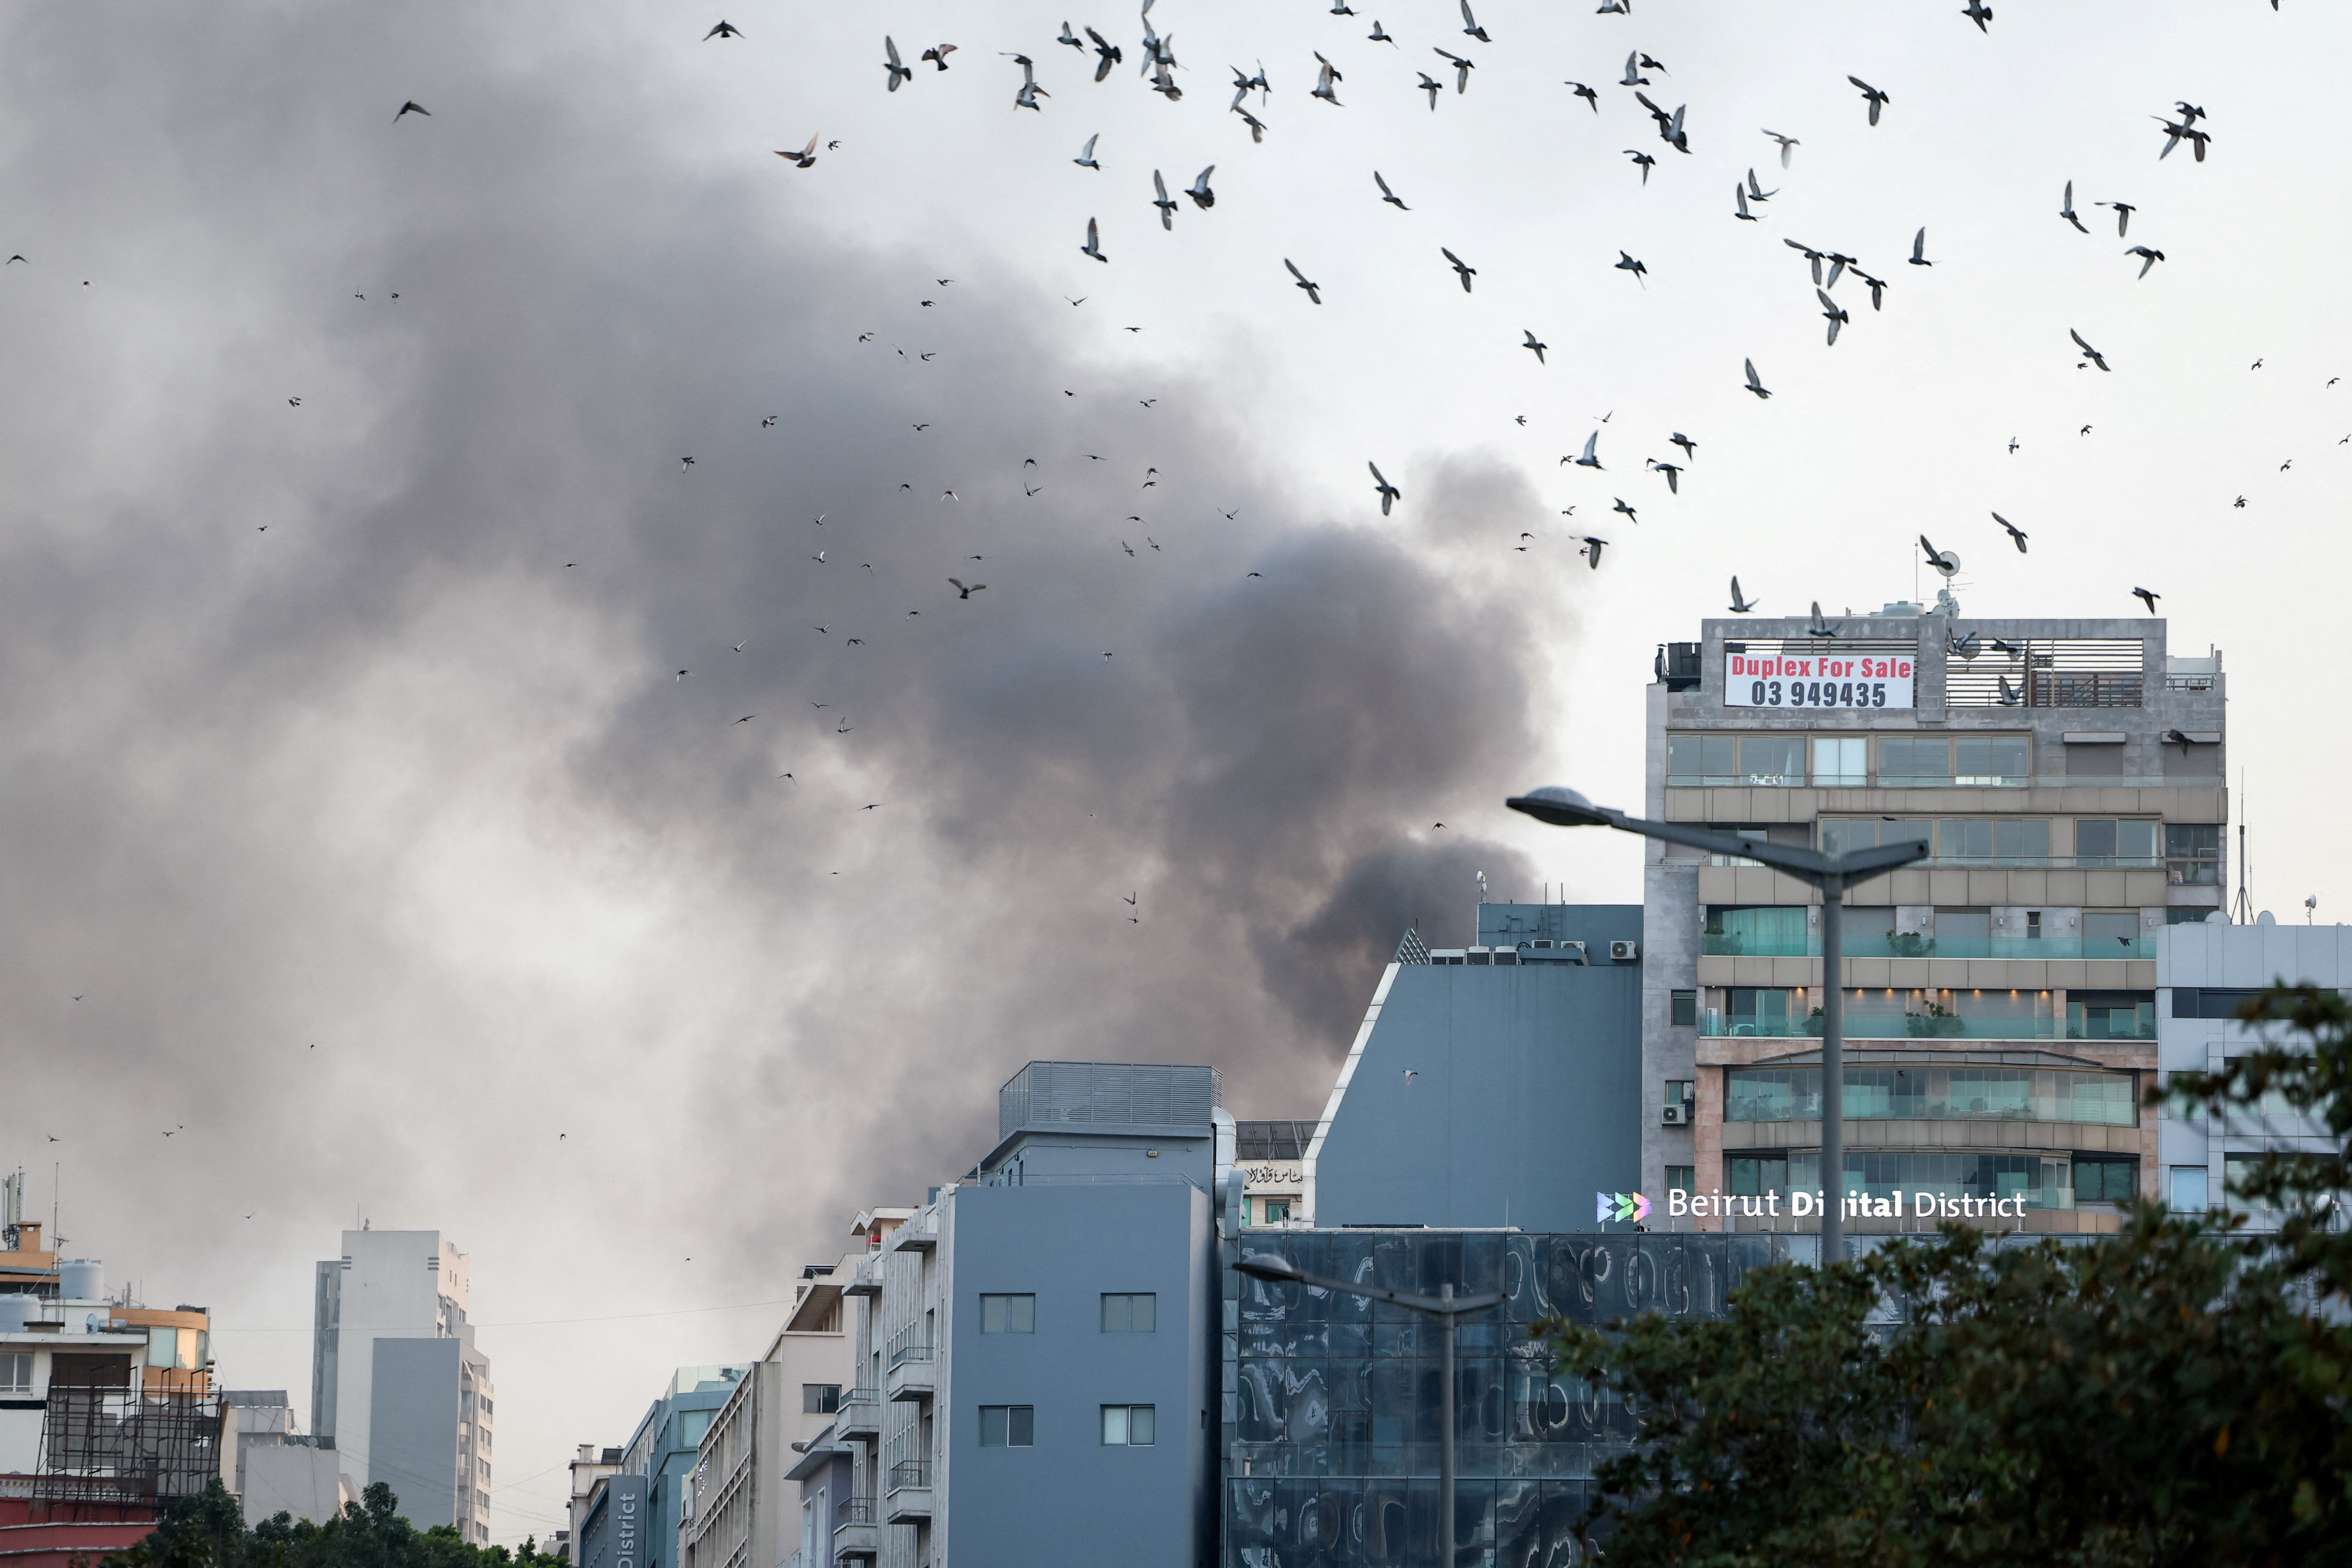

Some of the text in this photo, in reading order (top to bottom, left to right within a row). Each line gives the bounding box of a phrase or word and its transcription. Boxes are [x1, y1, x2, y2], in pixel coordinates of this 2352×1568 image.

[1732, 656, 1911, 680] Duplex For Sale
[1752, 681, 1885, 706] 03 949435
[1669, 1187, 2026, 1223] Beirut Diital District
